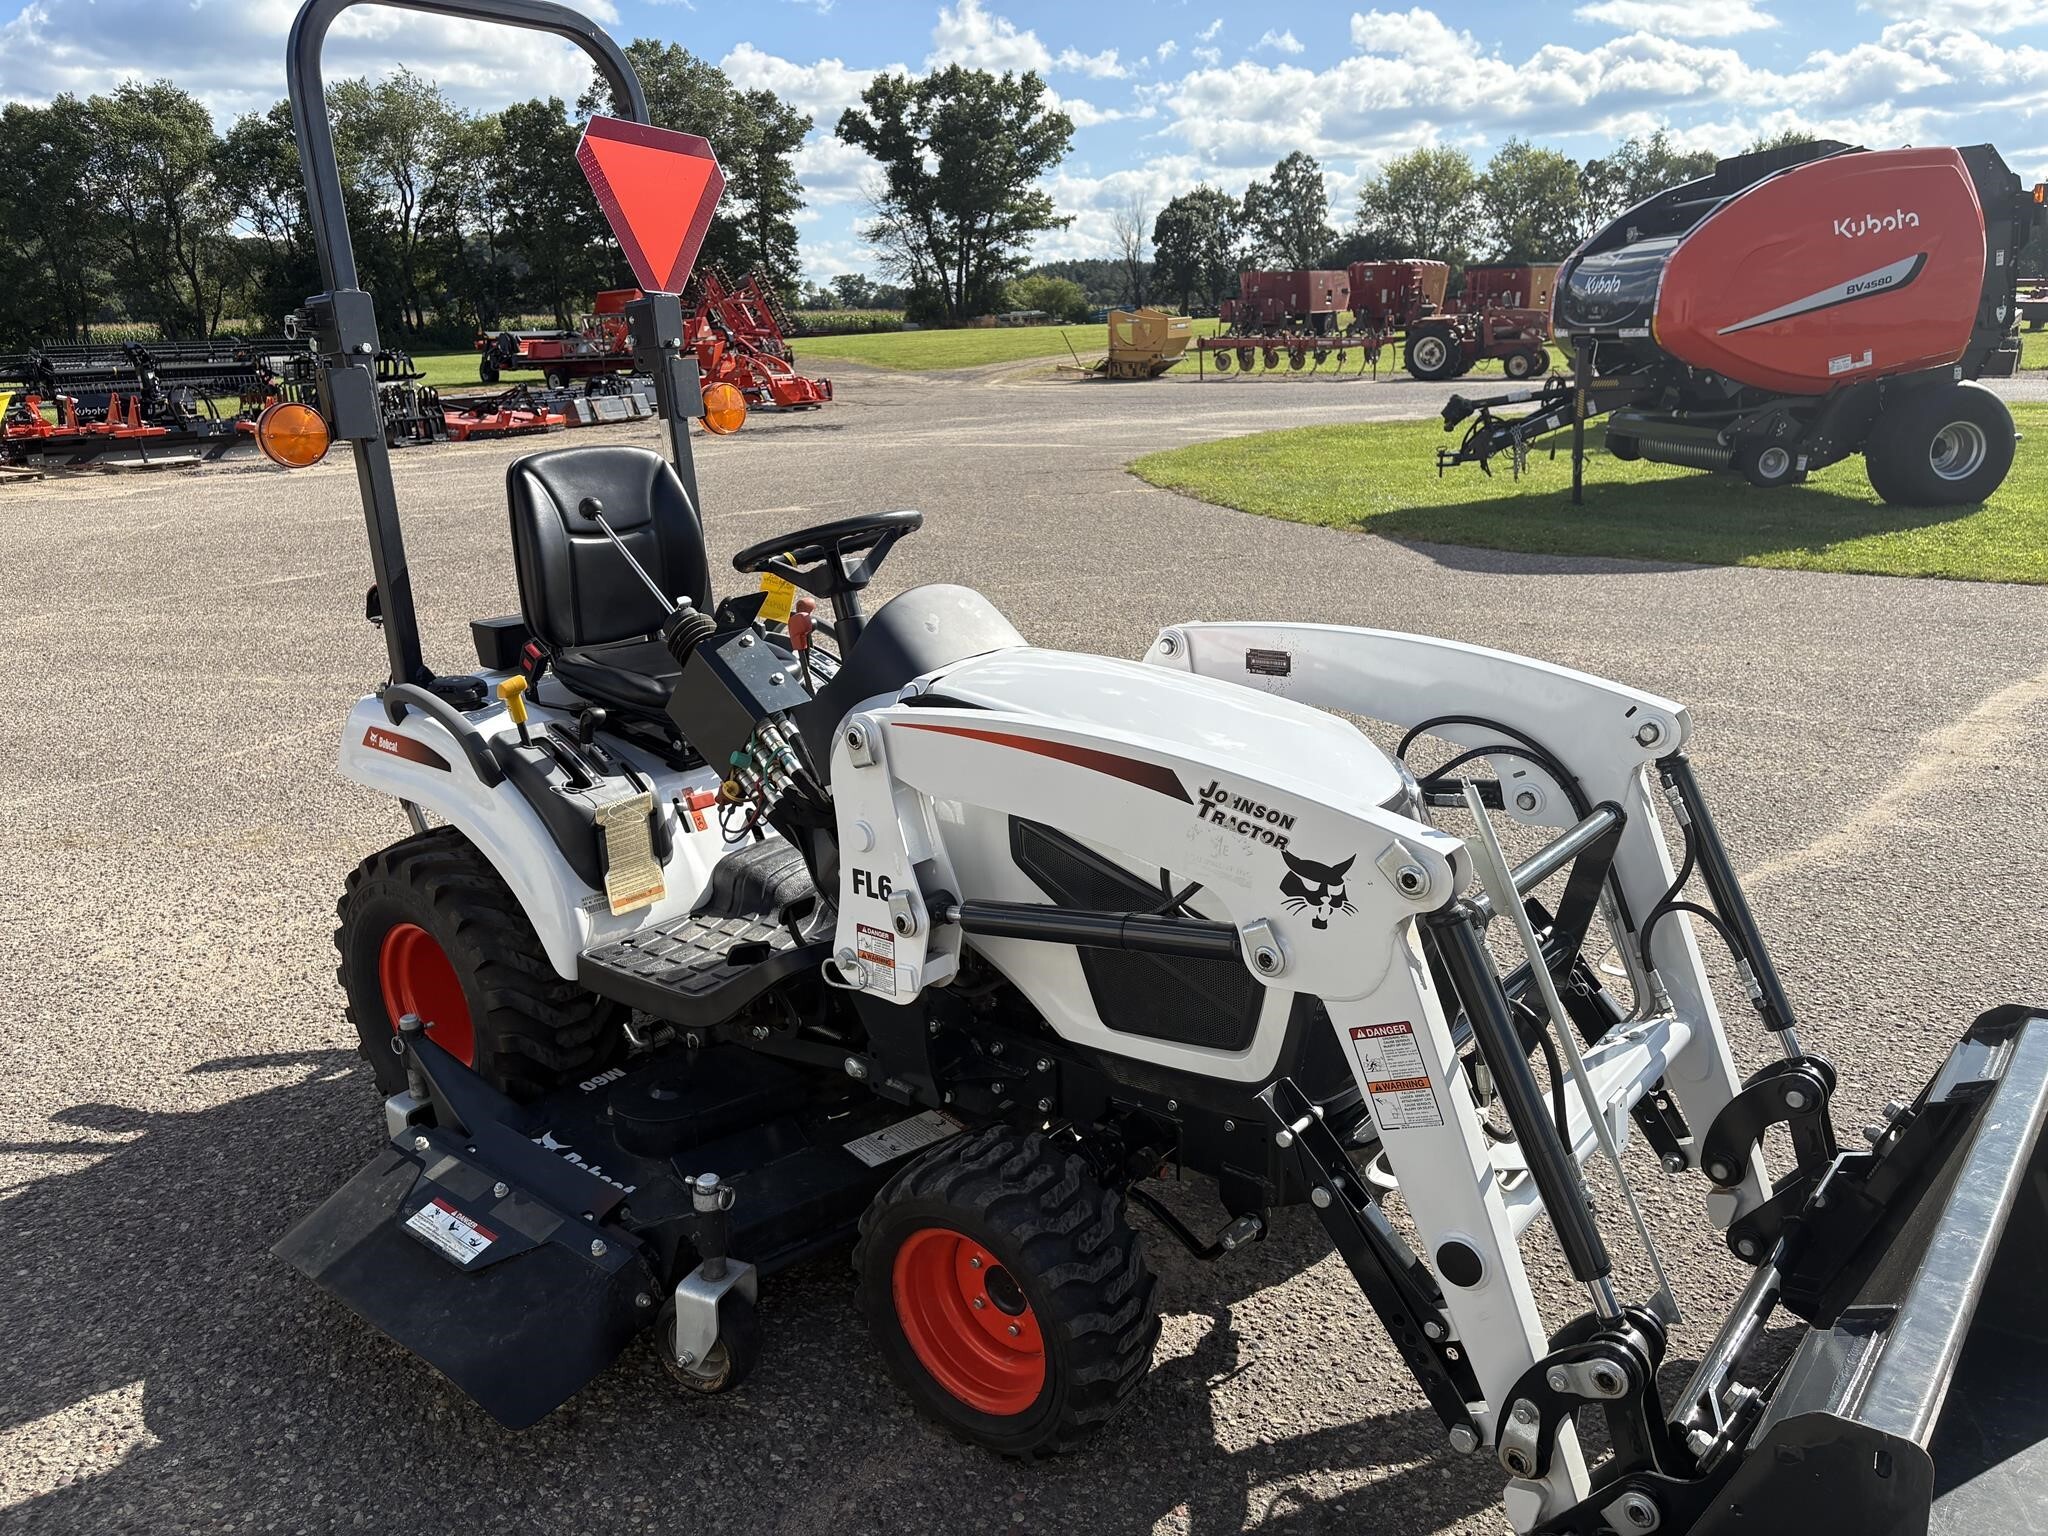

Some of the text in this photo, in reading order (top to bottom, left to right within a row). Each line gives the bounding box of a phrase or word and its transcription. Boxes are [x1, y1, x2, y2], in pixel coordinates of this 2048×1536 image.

[1833, 208, 1920, 239] Kubota
[1584, 274, 1621, 295] Kubota
[1846, 275, 1893, 295] BV4580
[379, 736, 398, 752] Bobcat
[852, 868, 893, 902] FL6
[867, 928, 889, 940] DANGER
[1366, 1025, 1407, 1037] DANGER
[579, 1067, 627, 1091] M60
[1382, 1079, 1425, 1090] WARNING
[455, 1212, 478, 1229] DANGER
